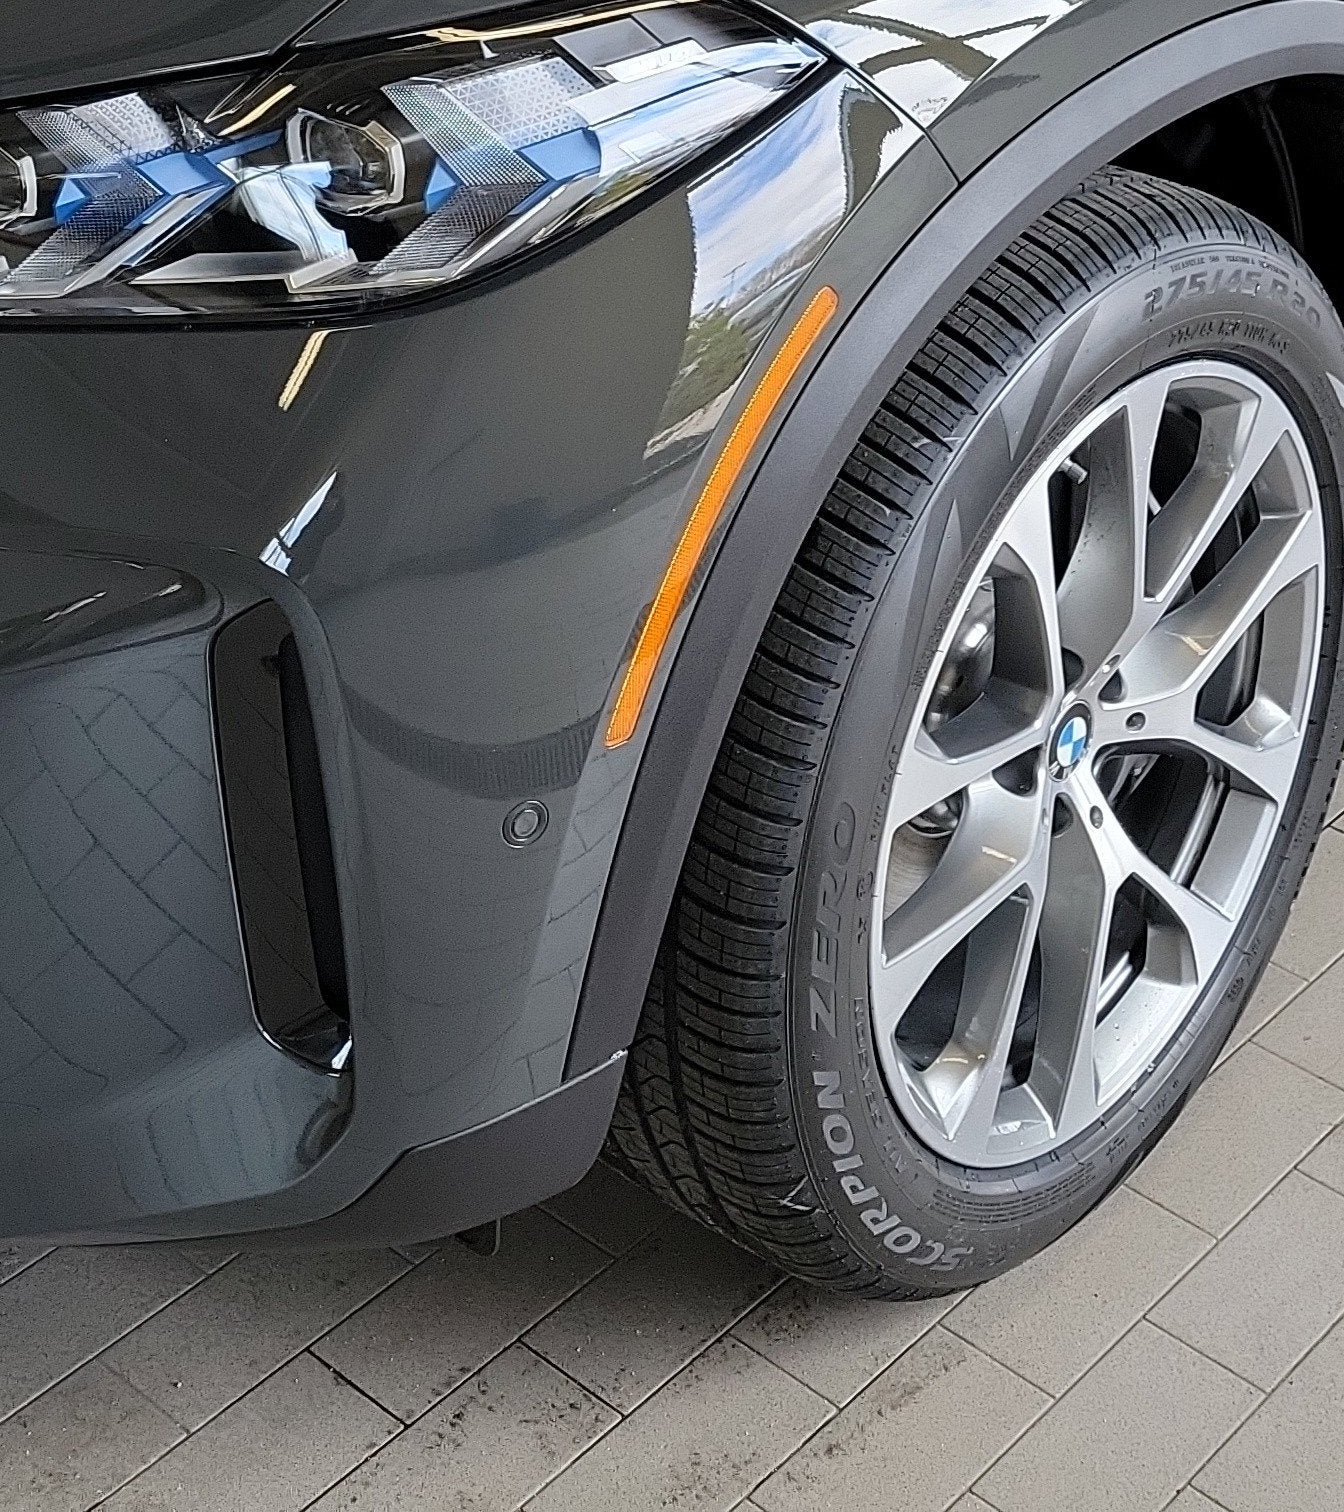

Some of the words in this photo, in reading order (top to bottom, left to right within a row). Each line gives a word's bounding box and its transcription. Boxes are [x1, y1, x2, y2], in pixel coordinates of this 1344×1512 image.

[1142, 268, 1262, 323] 275/45
[809, 801, 856, 1038] ZERO
[812, 1070, 974, 1271] SCORPION
